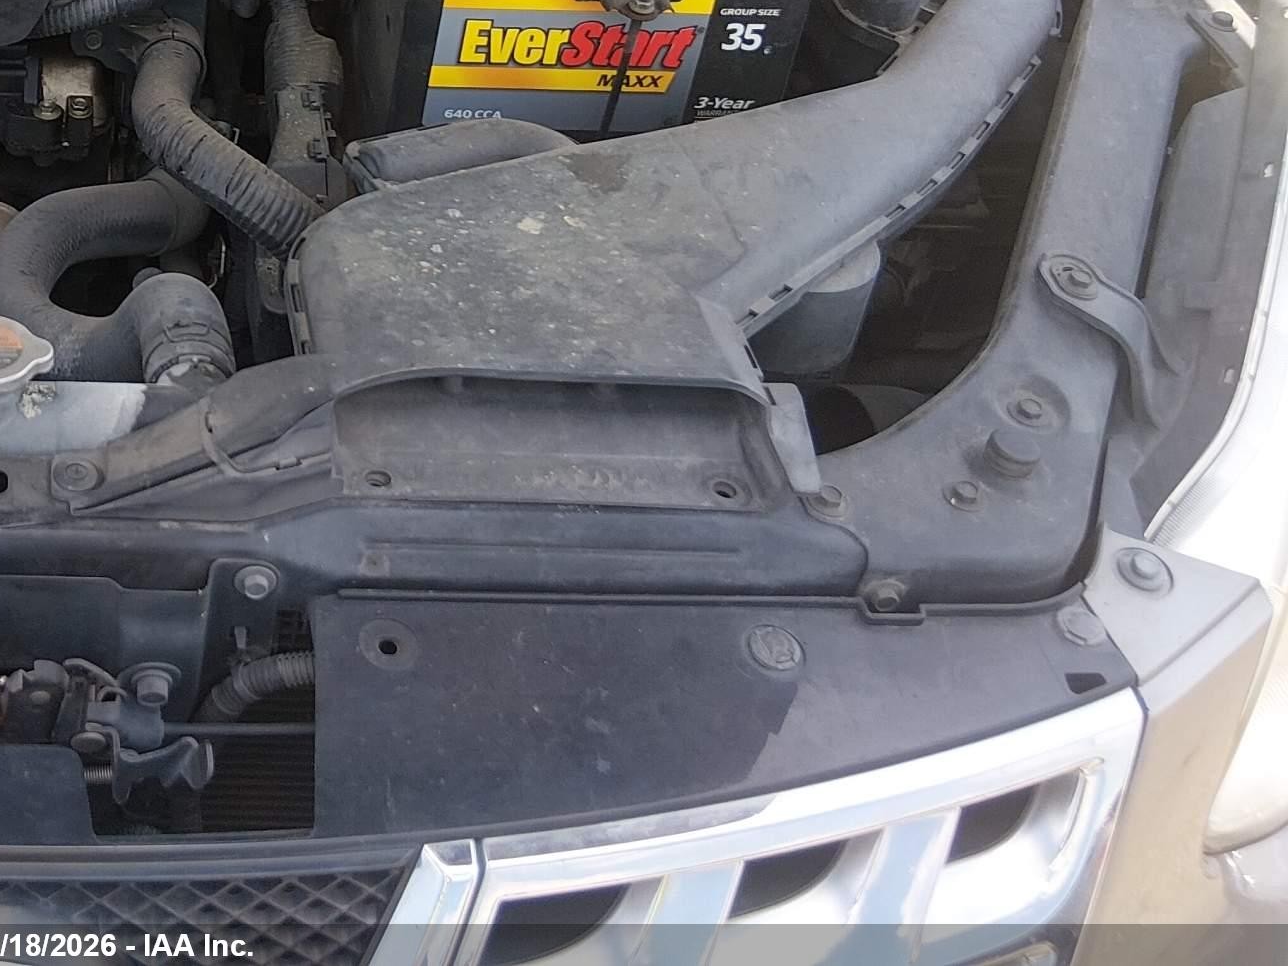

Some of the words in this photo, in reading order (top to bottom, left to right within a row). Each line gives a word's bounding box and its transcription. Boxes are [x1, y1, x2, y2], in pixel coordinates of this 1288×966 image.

[720, 8, 757, 16] GROUP
[757, 8, 781, 16] SIZE
[720, 22, 767, 51] 35
[457, 18, 699, 70] EverStart
[596, 74, 663, 88] MAXX
[694, 97, 755, 110] 3-Year
[444, 109, 472, 119] 640
[474, 109, 501, 119] CCA
